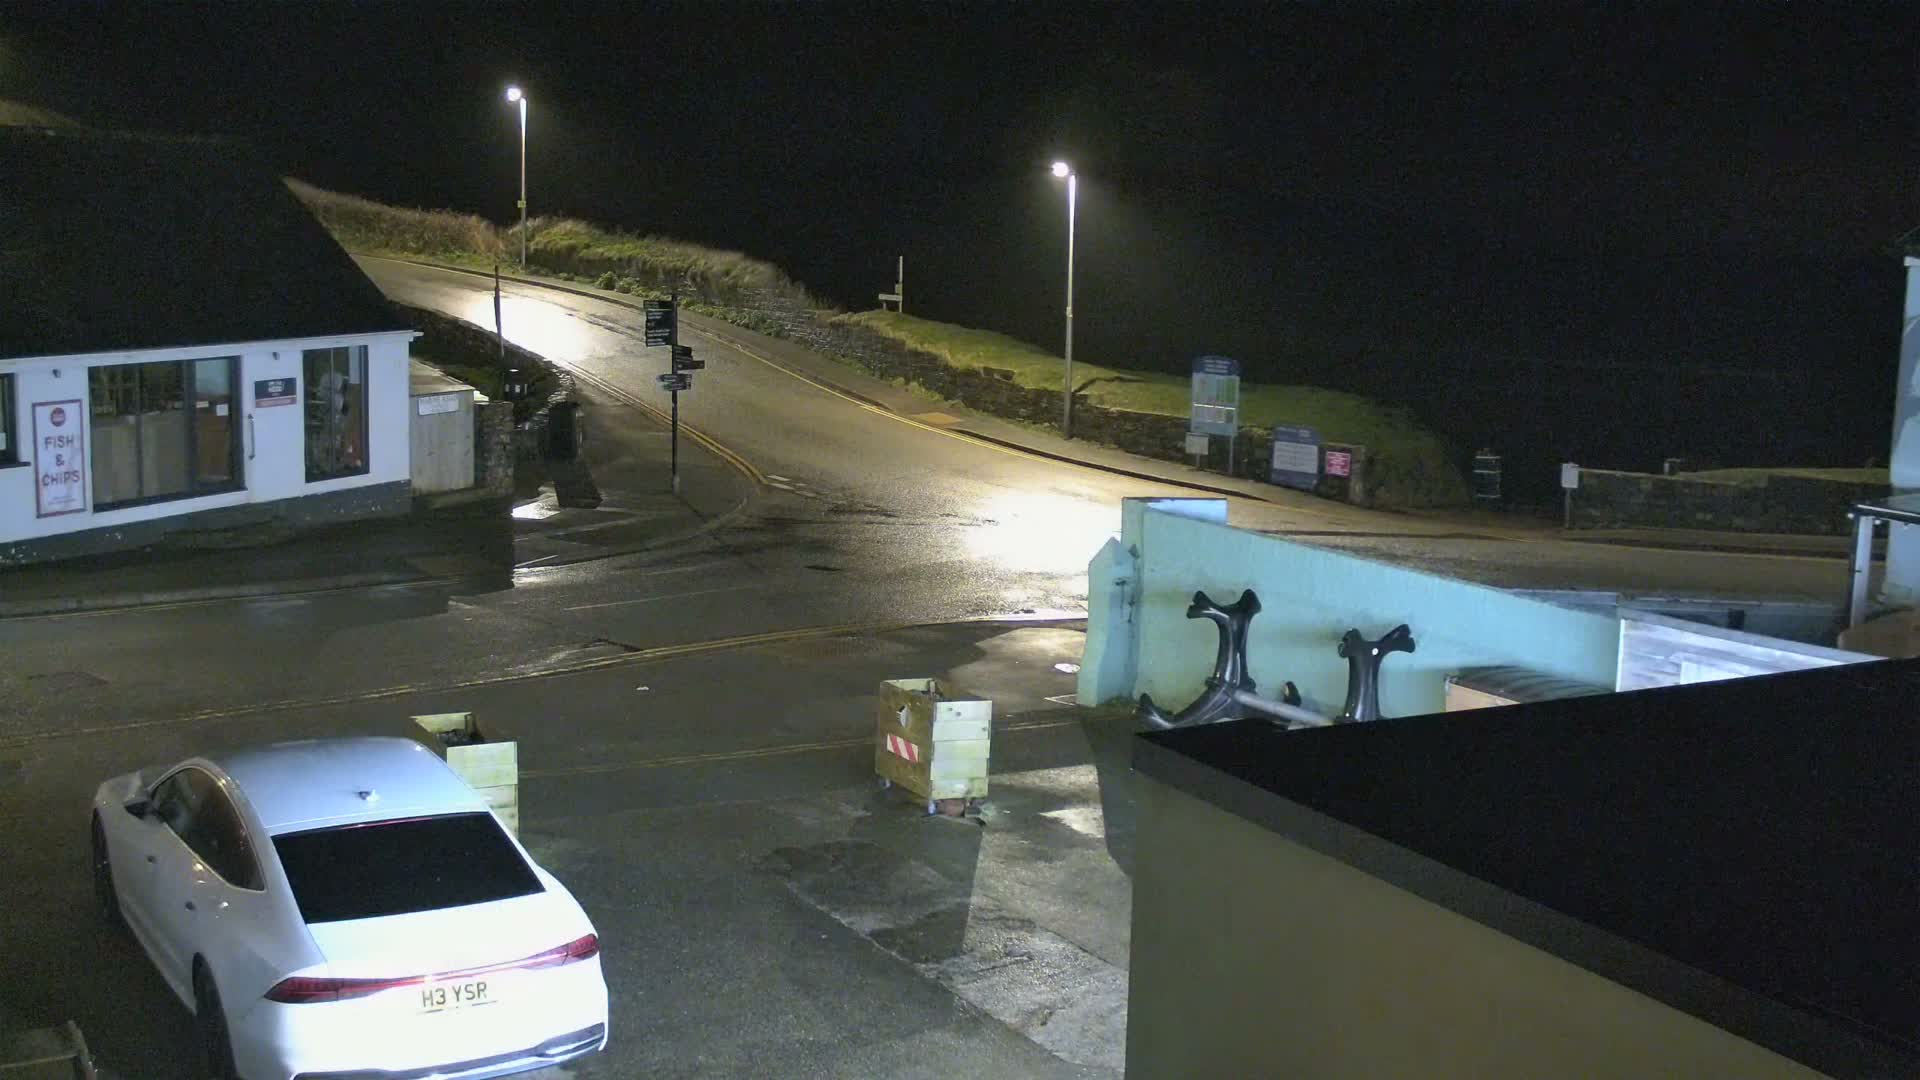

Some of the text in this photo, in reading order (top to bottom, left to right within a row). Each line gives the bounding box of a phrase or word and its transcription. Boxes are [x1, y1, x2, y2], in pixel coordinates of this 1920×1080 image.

[44, 434, 74, 449] FISH
[55, 453, 65, 467] &
[42, 470, 80, 487] CHIPS
[422, 981, 487, 1008] H3 YSR
